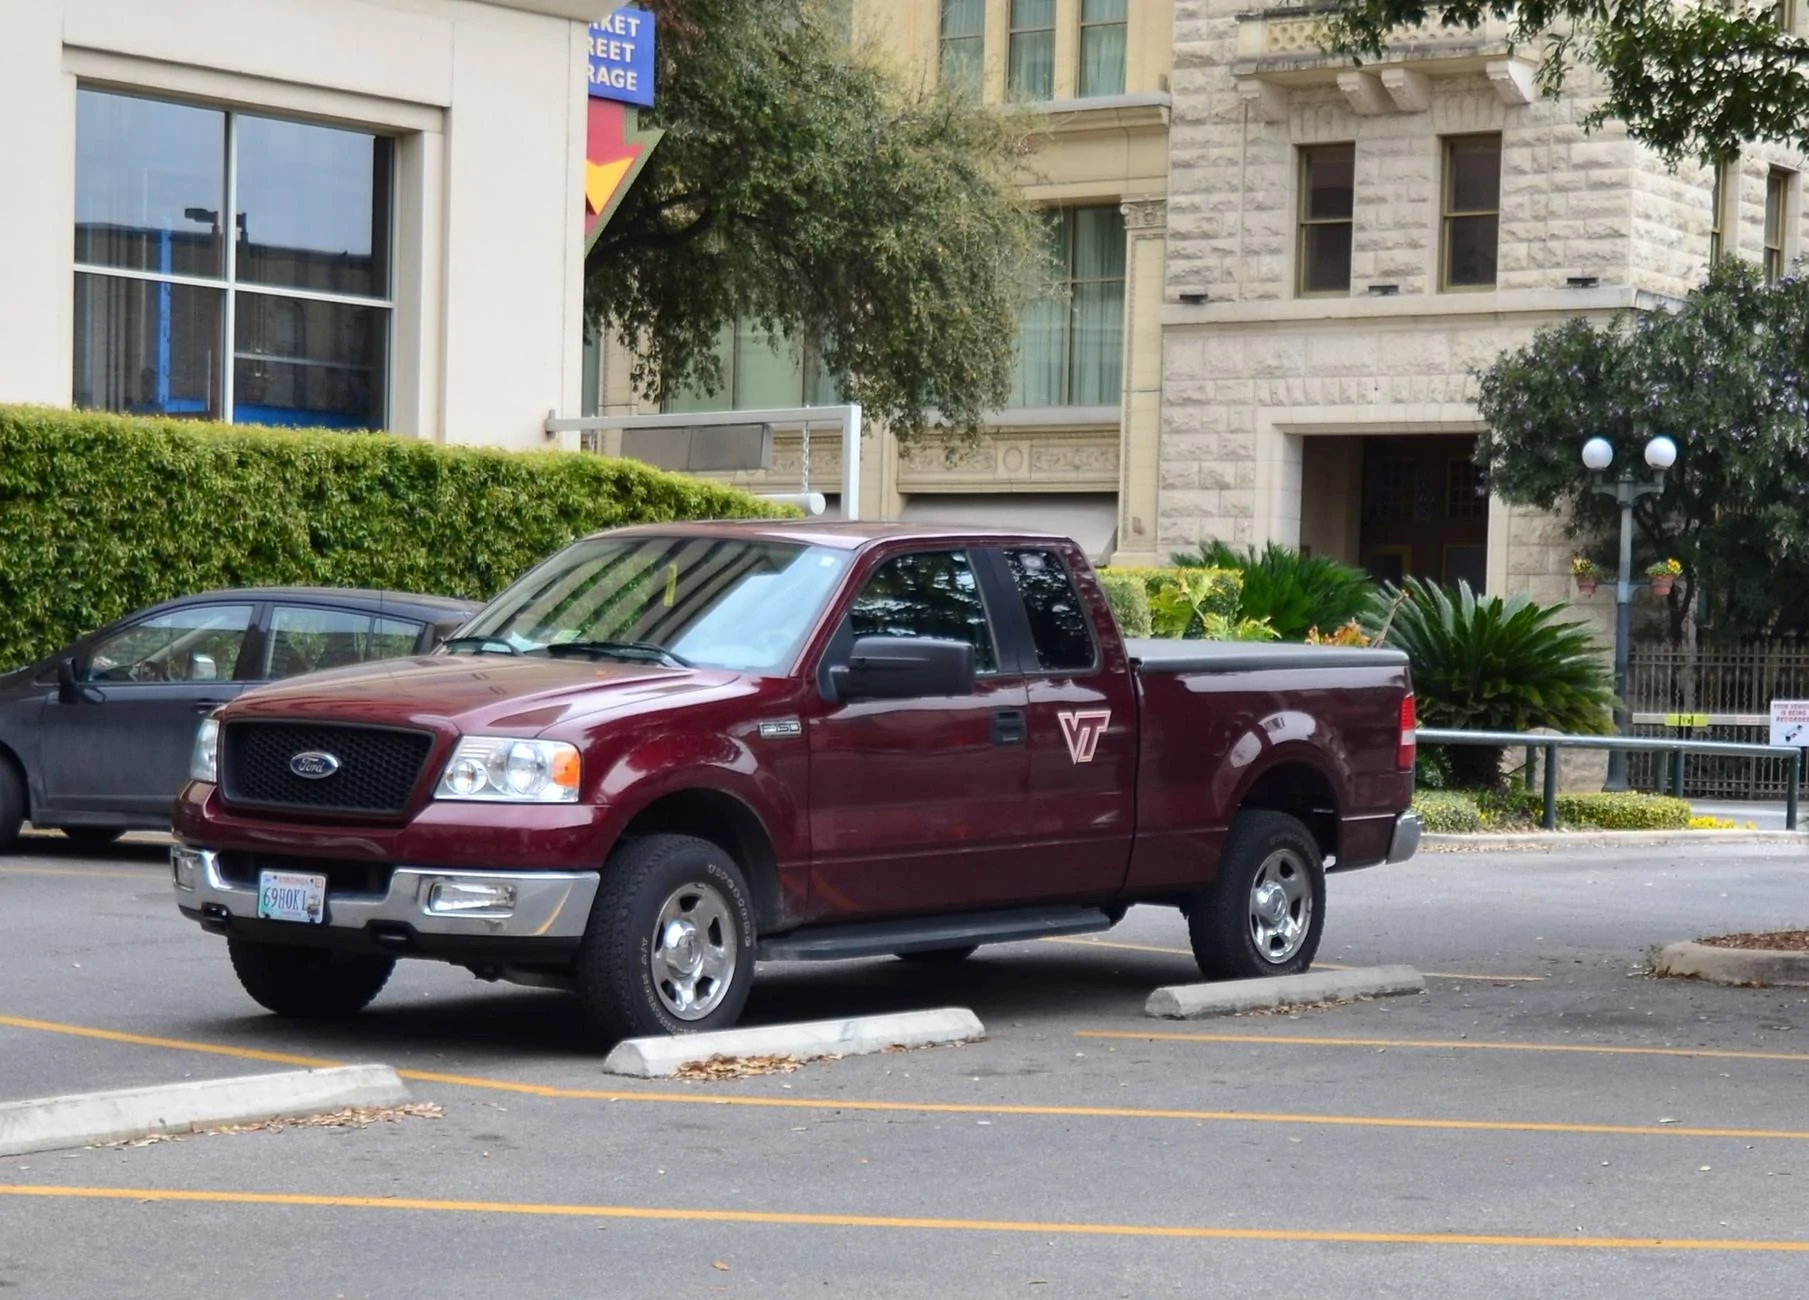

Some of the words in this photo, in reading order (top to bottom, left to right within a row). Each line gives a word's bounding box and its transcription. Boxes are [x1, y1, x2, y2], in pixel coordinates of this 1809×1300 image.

[587, 64, 638, 92] RAGE
[1057, 710, 1112, 765] VT
[299, 758, 325, 773] Ford
